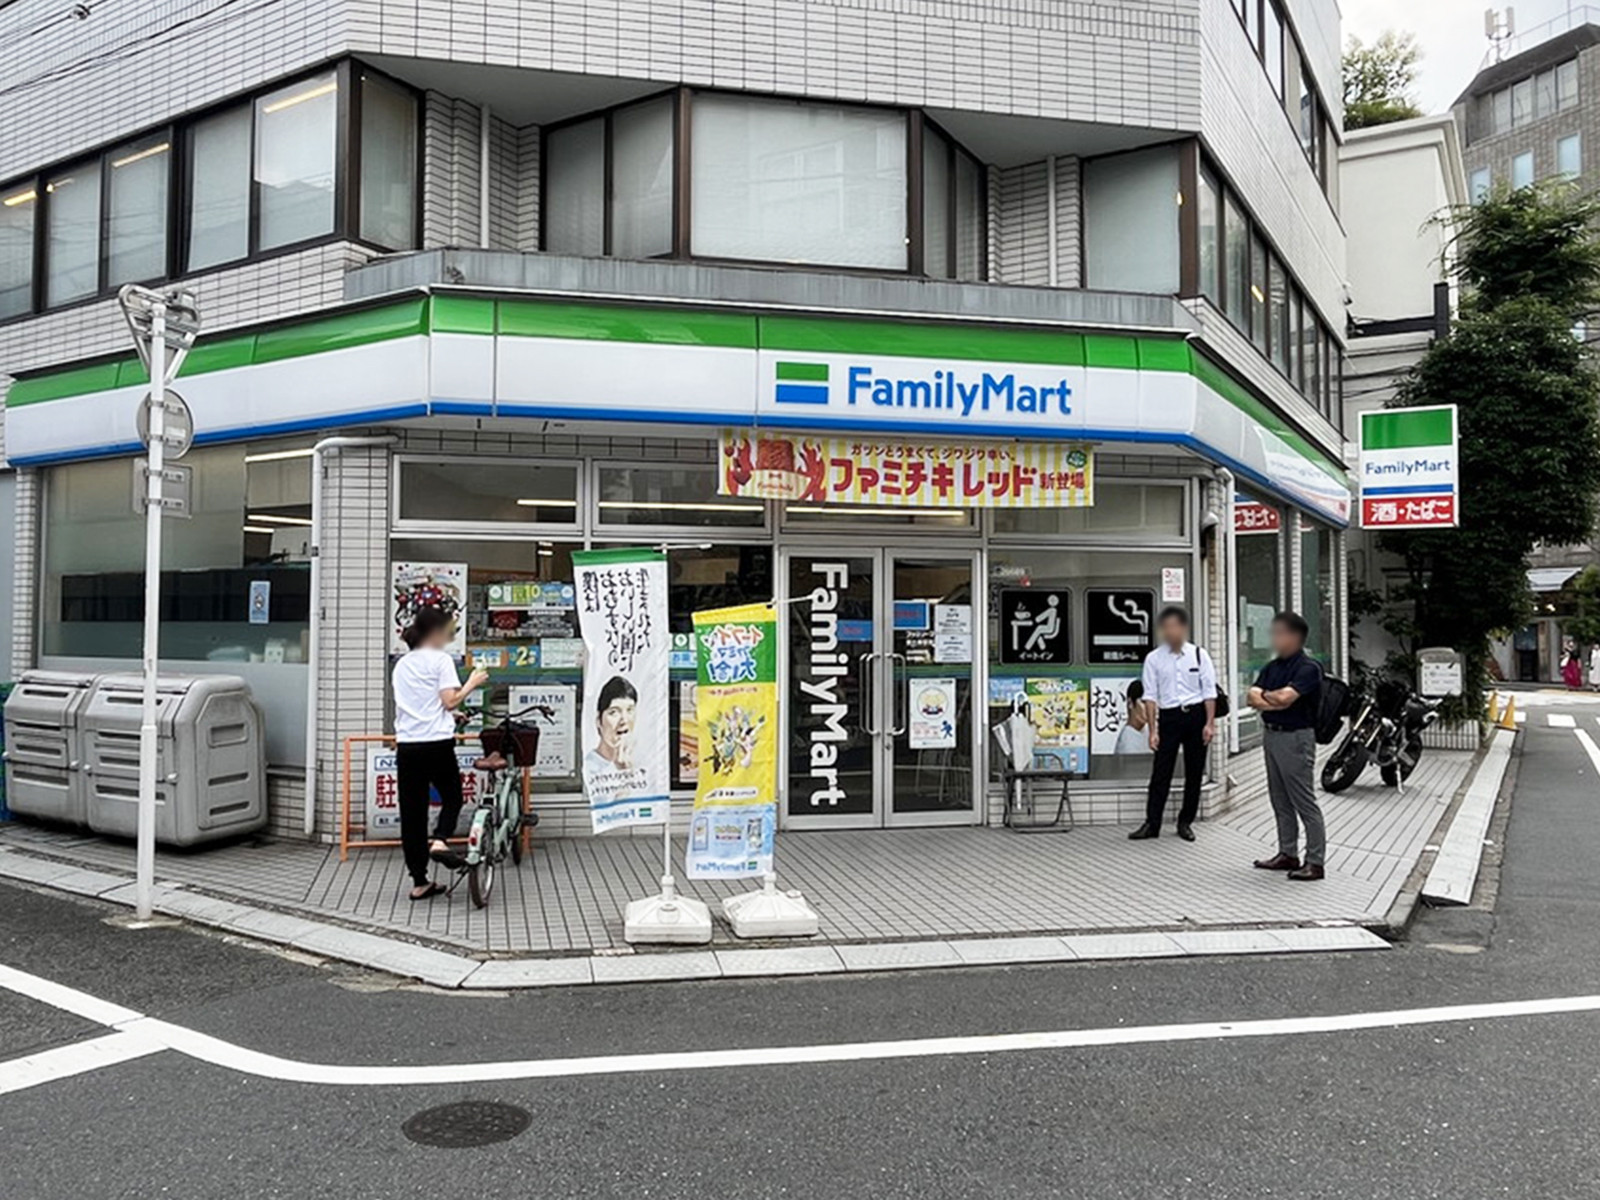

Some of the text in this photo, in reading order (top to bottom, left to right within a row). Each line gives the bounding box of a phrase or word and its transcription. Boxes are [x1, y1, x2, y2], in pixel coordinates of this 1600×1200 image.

[848, 366, 1072, 416] FamilyMart
[830, 458, 1037, 497] ファミチキレッド
[1365, 459, 1451, 476] FamilyMart
[1040, 471, 1085, 490] 新登場
[1370, 500, 1451, 522] 酒・たばこ
[1019, 651, 1054, 660] イートイン
[800, 563, 848, 806] FamilyMart
